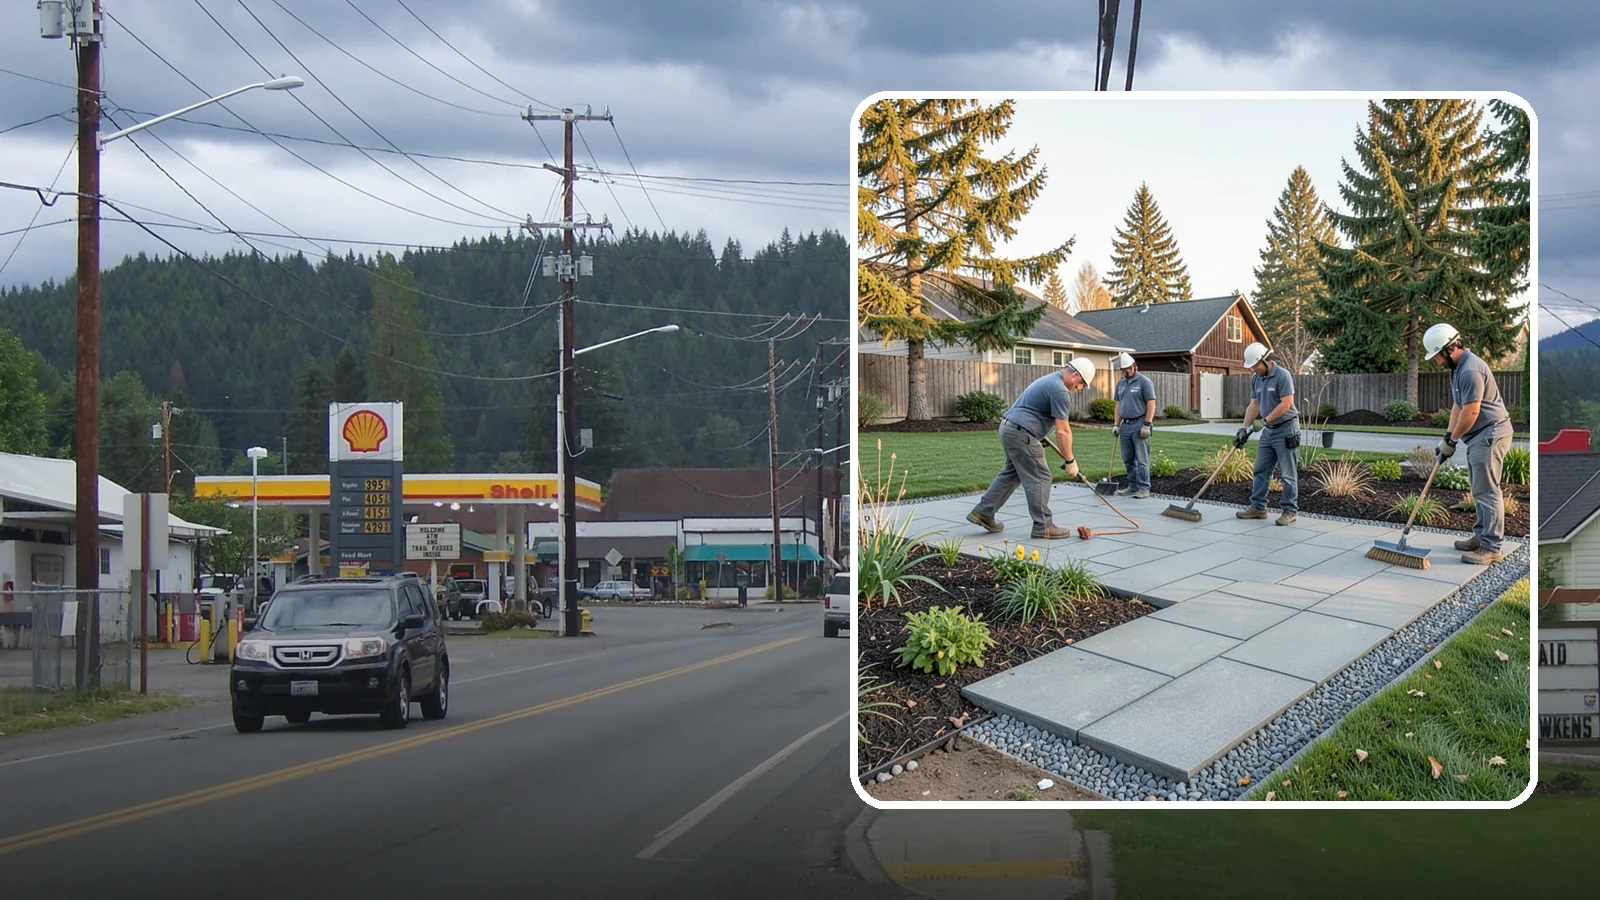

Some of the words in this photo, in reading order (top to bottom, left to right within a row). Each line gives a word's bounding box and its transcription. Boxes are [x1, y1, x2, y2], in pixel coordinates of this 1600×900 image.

[366, 480, 383, 490] 395
[490, 484, 547, 499] Shell
[366, 494, 383, 504] 405
[366, 508, 383, 518] 415
[366, 522, 383, 532] 429
